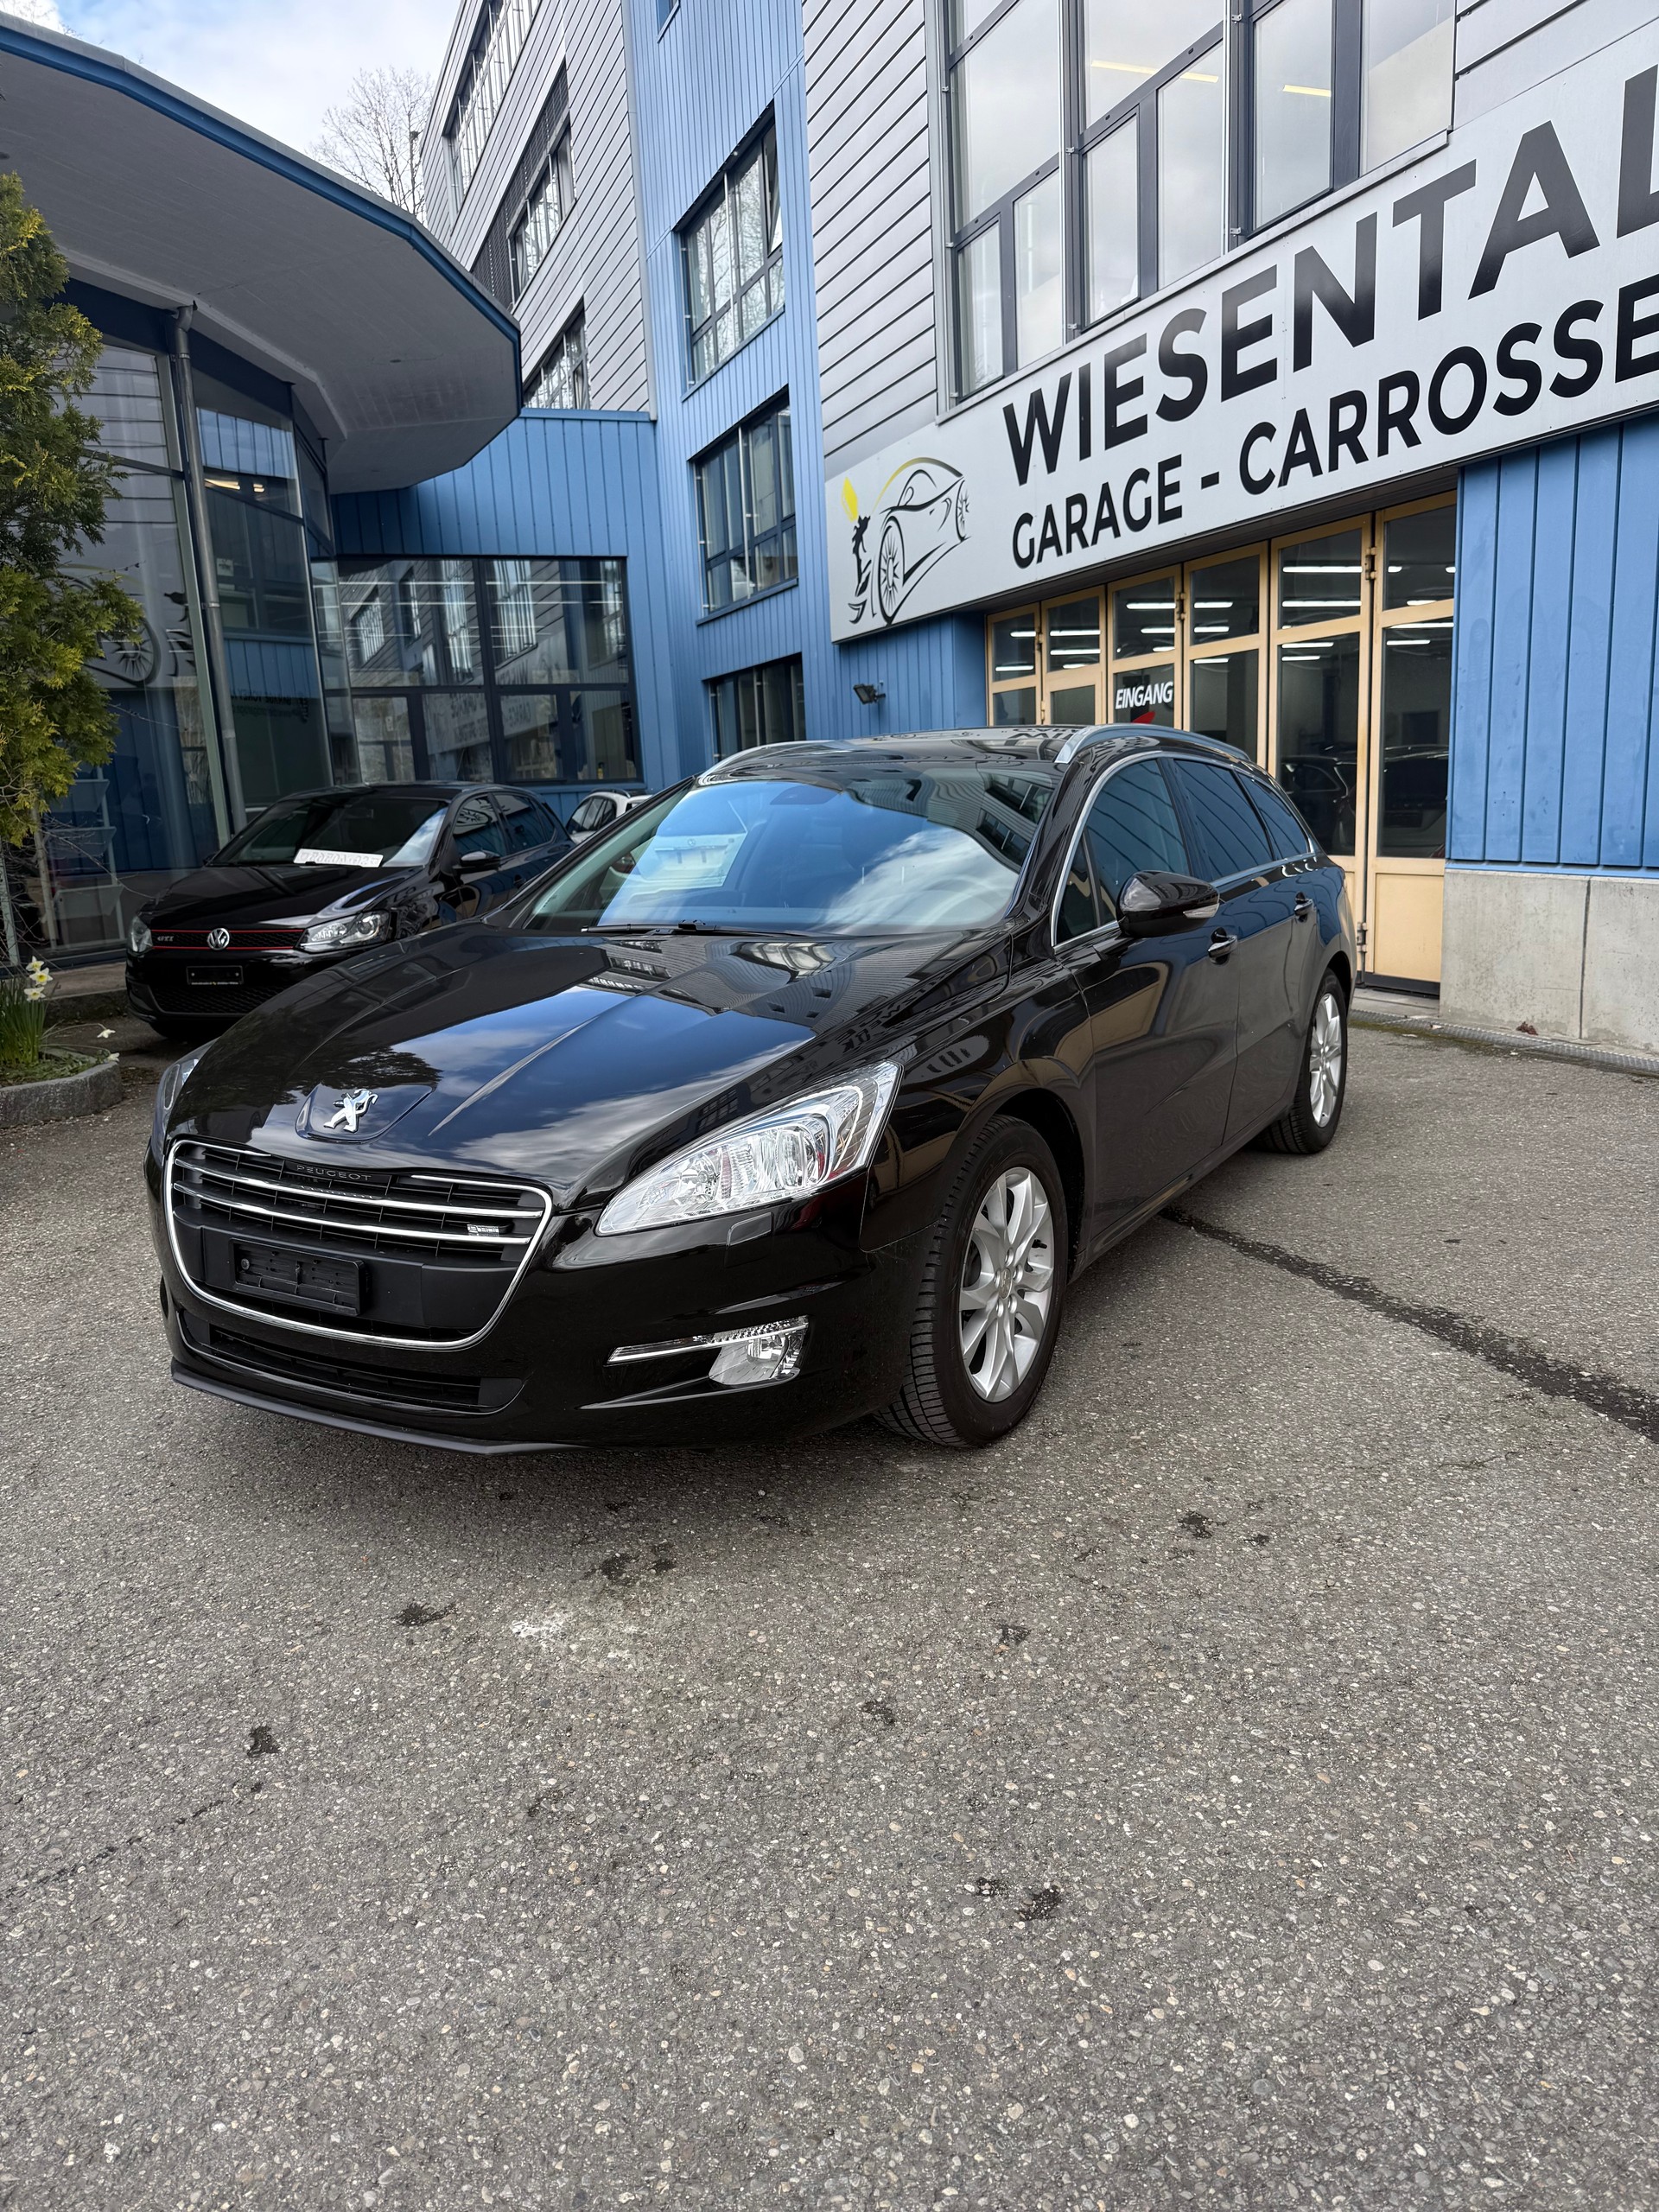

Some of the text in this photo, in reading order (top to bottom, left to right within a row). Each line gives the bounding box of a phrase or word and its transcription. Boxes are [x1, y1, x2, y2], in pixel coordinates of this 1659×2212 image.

[1002, 64, 1659, 486] WIESENTAL
[1012, 274, 1659, 569] GARAGE - CARROSSE
[1115, 681, 1173, 709] EINGANG
[296, 1165, 372, 1181] PEUGEOT
